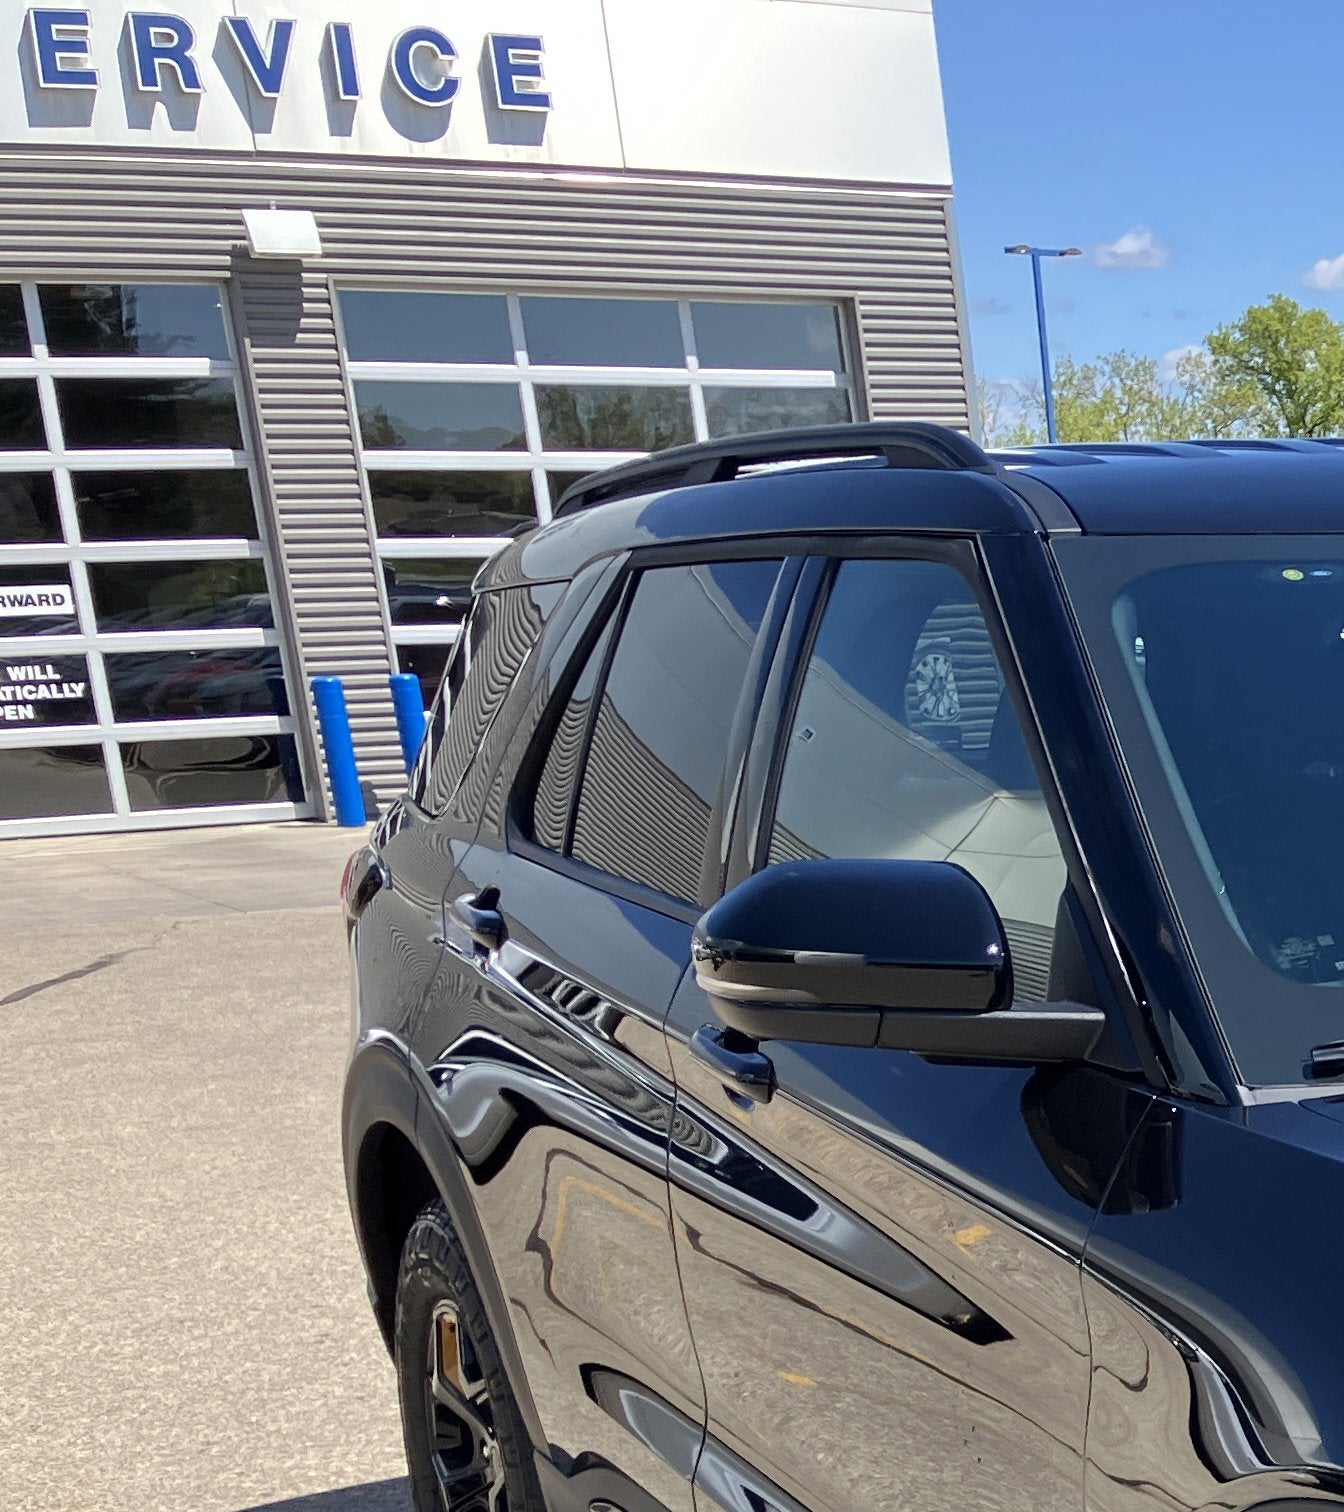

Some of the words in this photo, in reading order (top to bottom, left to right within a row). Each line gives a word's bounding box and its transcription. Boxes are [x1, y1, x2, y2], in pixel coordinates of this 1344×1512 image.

[28, 8, 554, 112] ERVICE
[6, 664, 60, 681] WILL
[0, 703, 35, 720] EN
